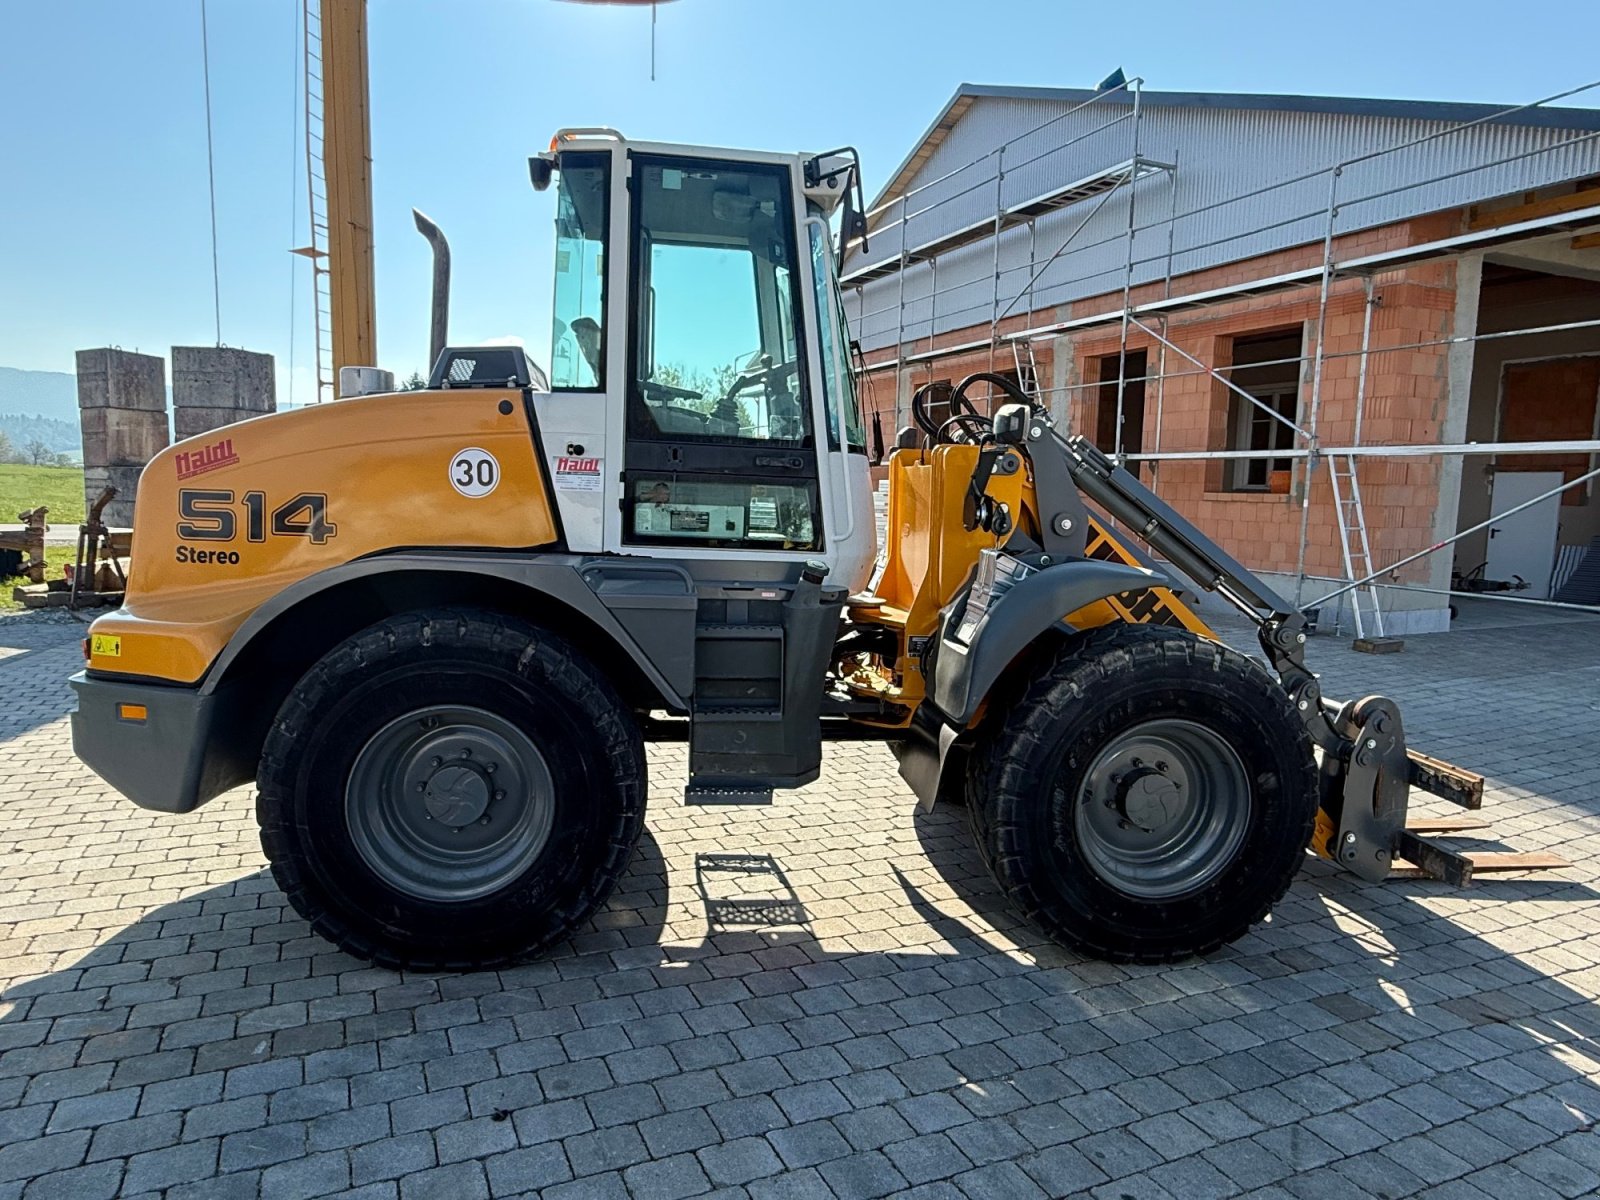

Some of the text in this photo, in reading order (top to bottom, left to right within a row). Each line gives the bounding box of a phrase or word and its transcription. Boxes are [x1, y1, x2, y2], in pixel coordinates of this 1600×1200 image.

[456, 459, 494, 487] 30
[176, 488, 337, 545] 514
[176, 545, 240, 565] Stereo
